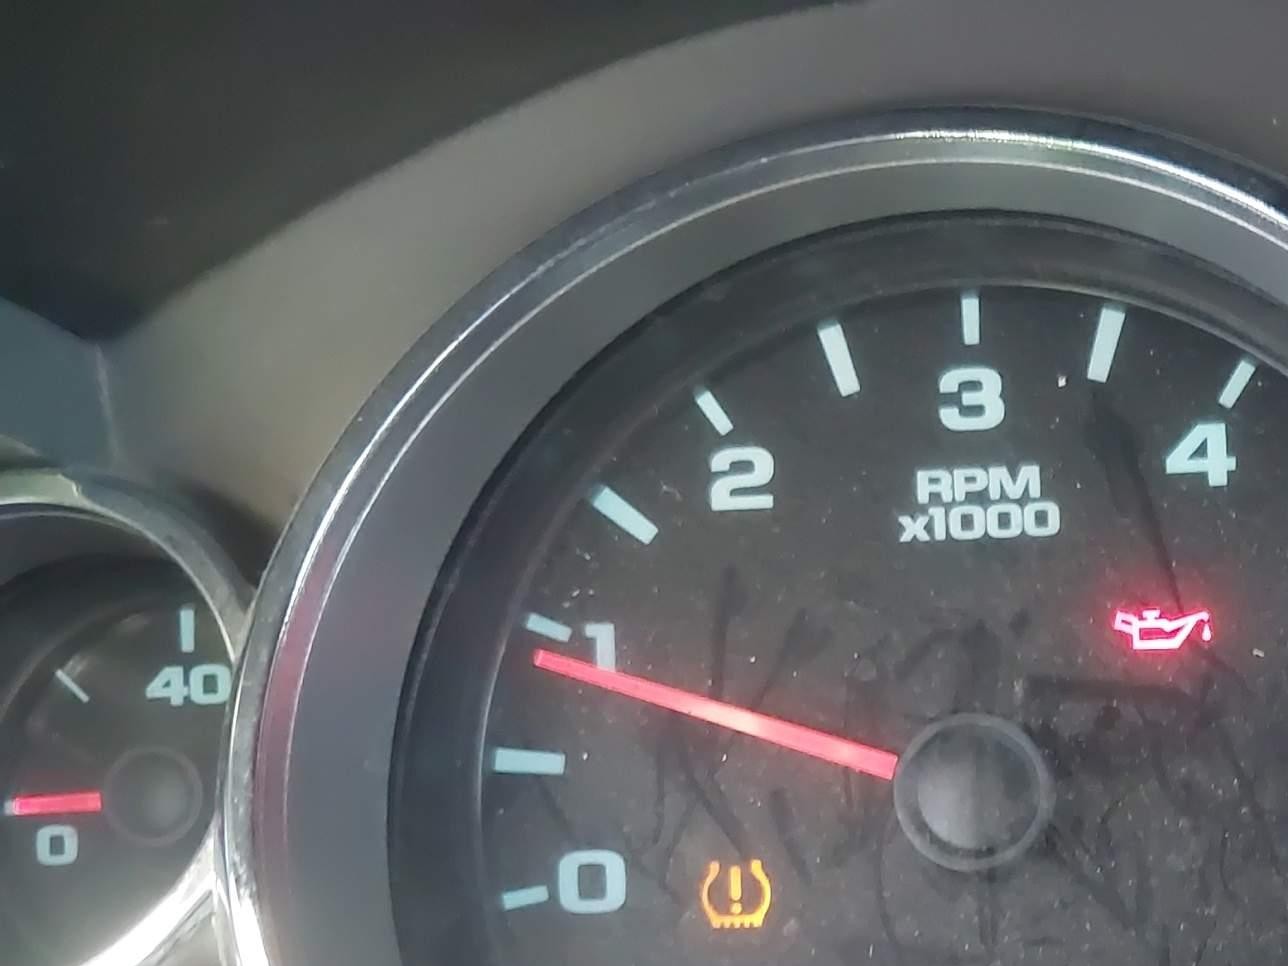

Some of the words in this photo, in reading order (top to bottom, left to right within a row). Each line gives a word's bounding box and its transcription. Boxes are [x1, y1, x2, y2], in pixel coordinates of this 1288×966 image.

[938, 366, 1005, 431] 3
[710, 446, 775, 511] 2
[1165, 422, 1236, 487] 4
[916, 464, 1041, 503] RPM
[898, 501, 1060, 542] x1000
[584, 623, 617, 672] 1
[145, 664, 232, 706] 40
[36, 825, 78, 866] 0
[557, 849, 626, 914] 0
